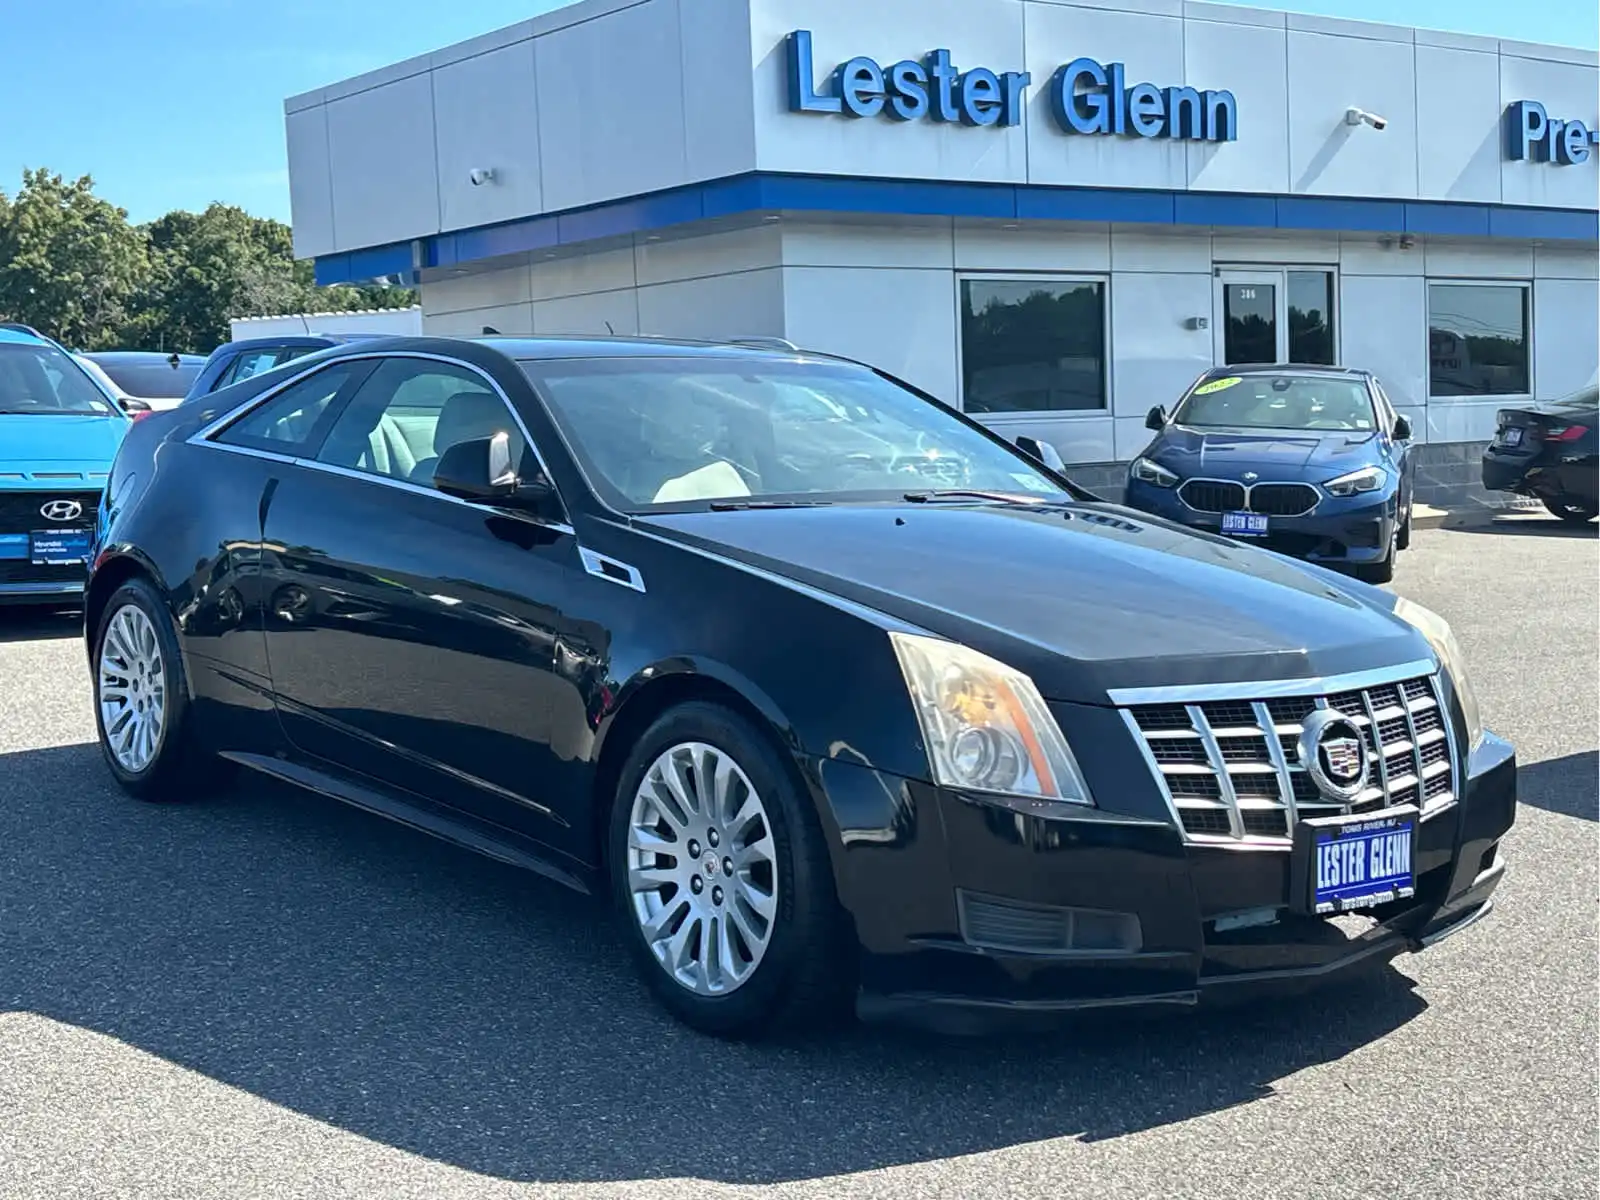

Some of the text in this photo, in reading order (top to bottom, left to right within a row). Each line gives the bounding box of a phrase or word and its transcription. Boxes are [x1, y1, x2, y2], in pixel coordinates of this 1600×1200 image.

[787, 30, 1238, 141] Lester Glenn
[1508, 100, 1599, 165] Pre-
[1223, 513, 1268, 530] LESTER GLENN
[1317, 832, 1411, 889] LESTER GLENN
